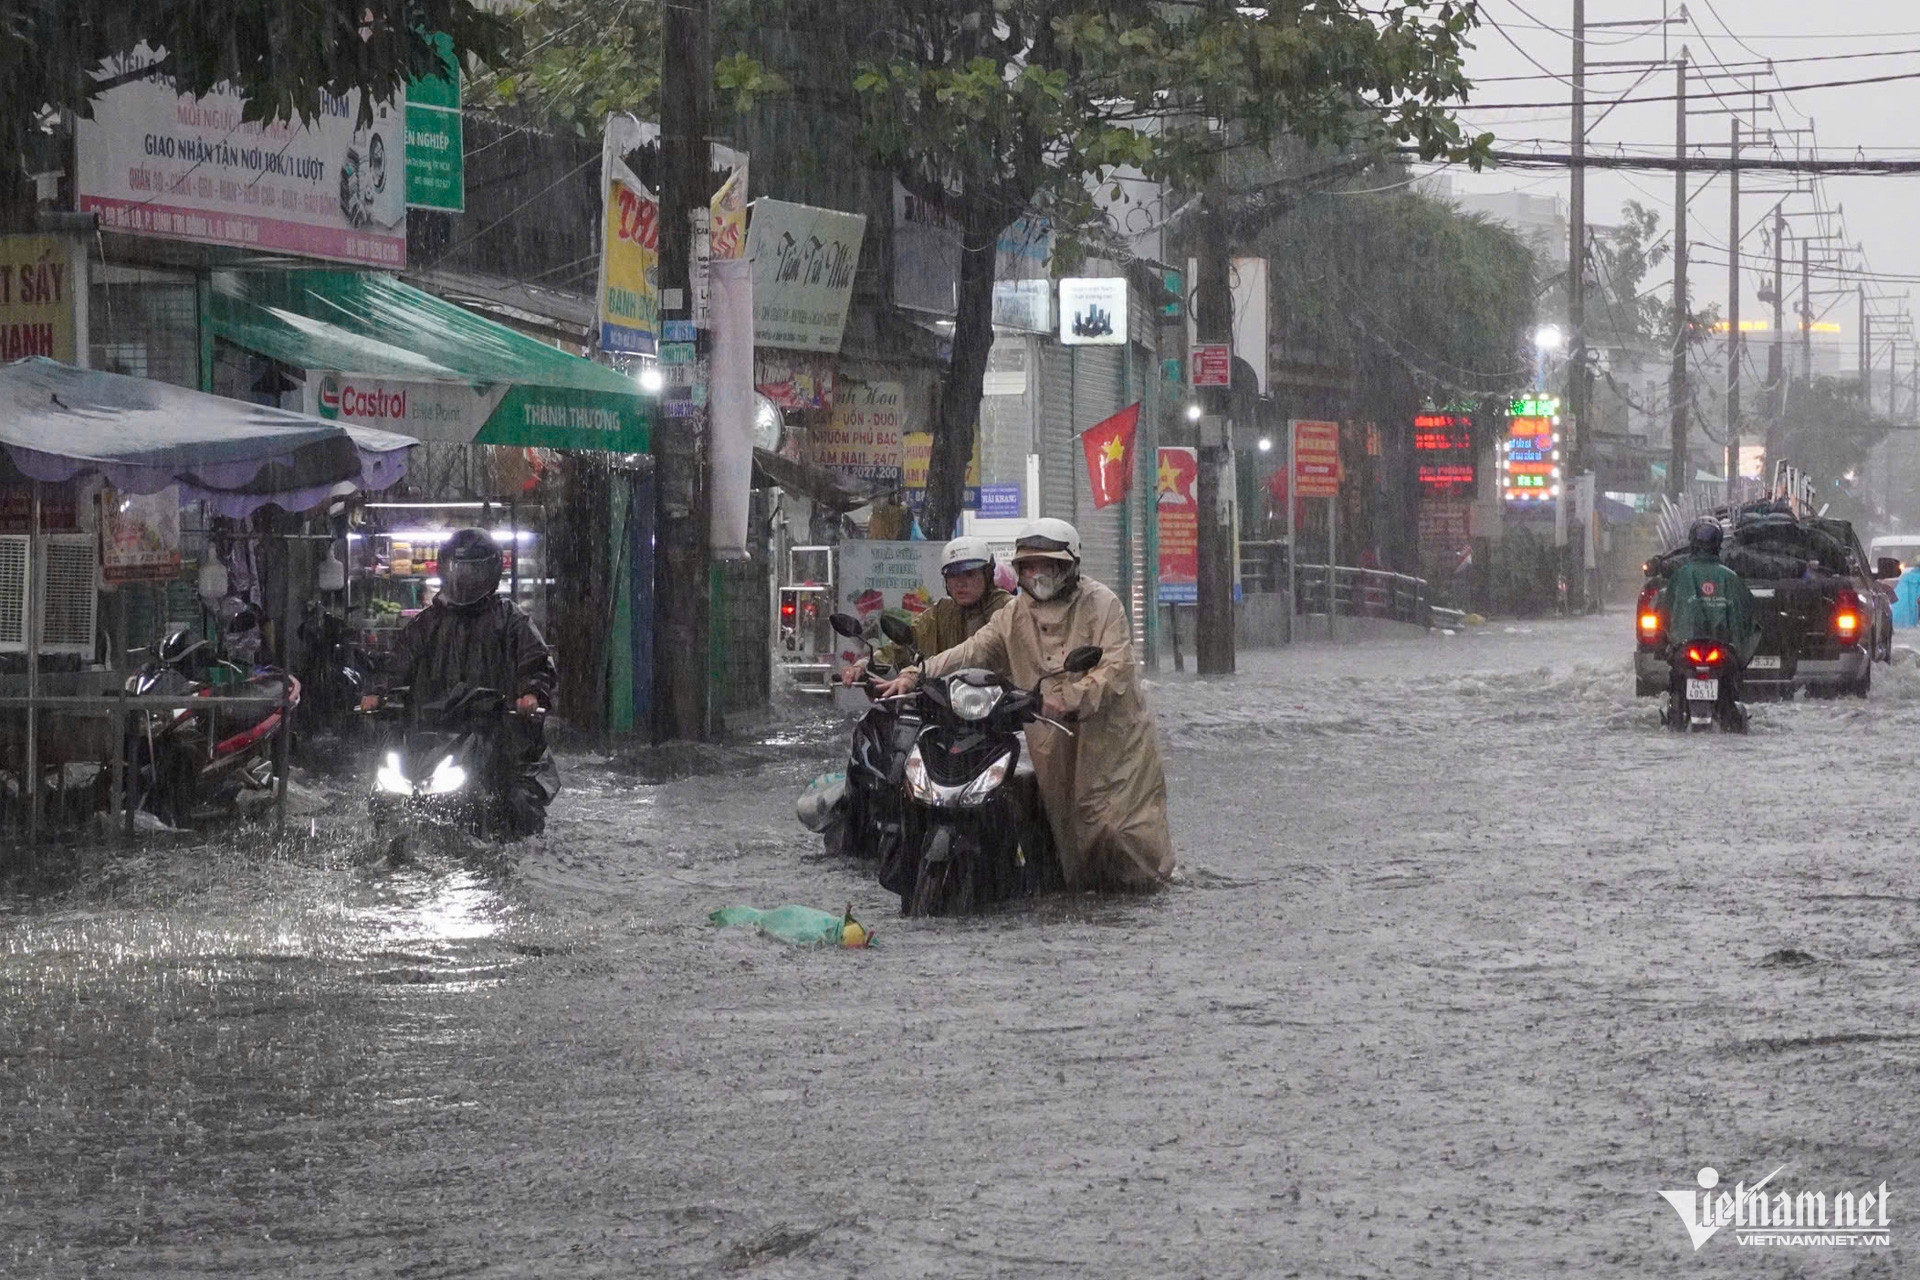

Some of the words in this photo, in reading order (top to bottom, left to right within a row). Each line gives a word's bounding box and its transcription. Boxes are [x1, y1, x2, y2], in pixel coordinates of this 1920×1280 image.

[416, 131, 450, 154] NGHIỆP
[144, 133, 175, 159] GIAO
[178, 136, 212, 166] NHẬN
[216, 139, 239, 170] TẬN
[297, 155, 325, 186] LƯỢT
[20, 248, 64, 305] SẤY
[341, 386, 407, 418] Castrol
[852, 426, 874, 446] PHỦ
[877, 433, 899, 450] BẠC
[841, 451, 868, 466] NAIL
[872, 454, 898, 468] 24/7
